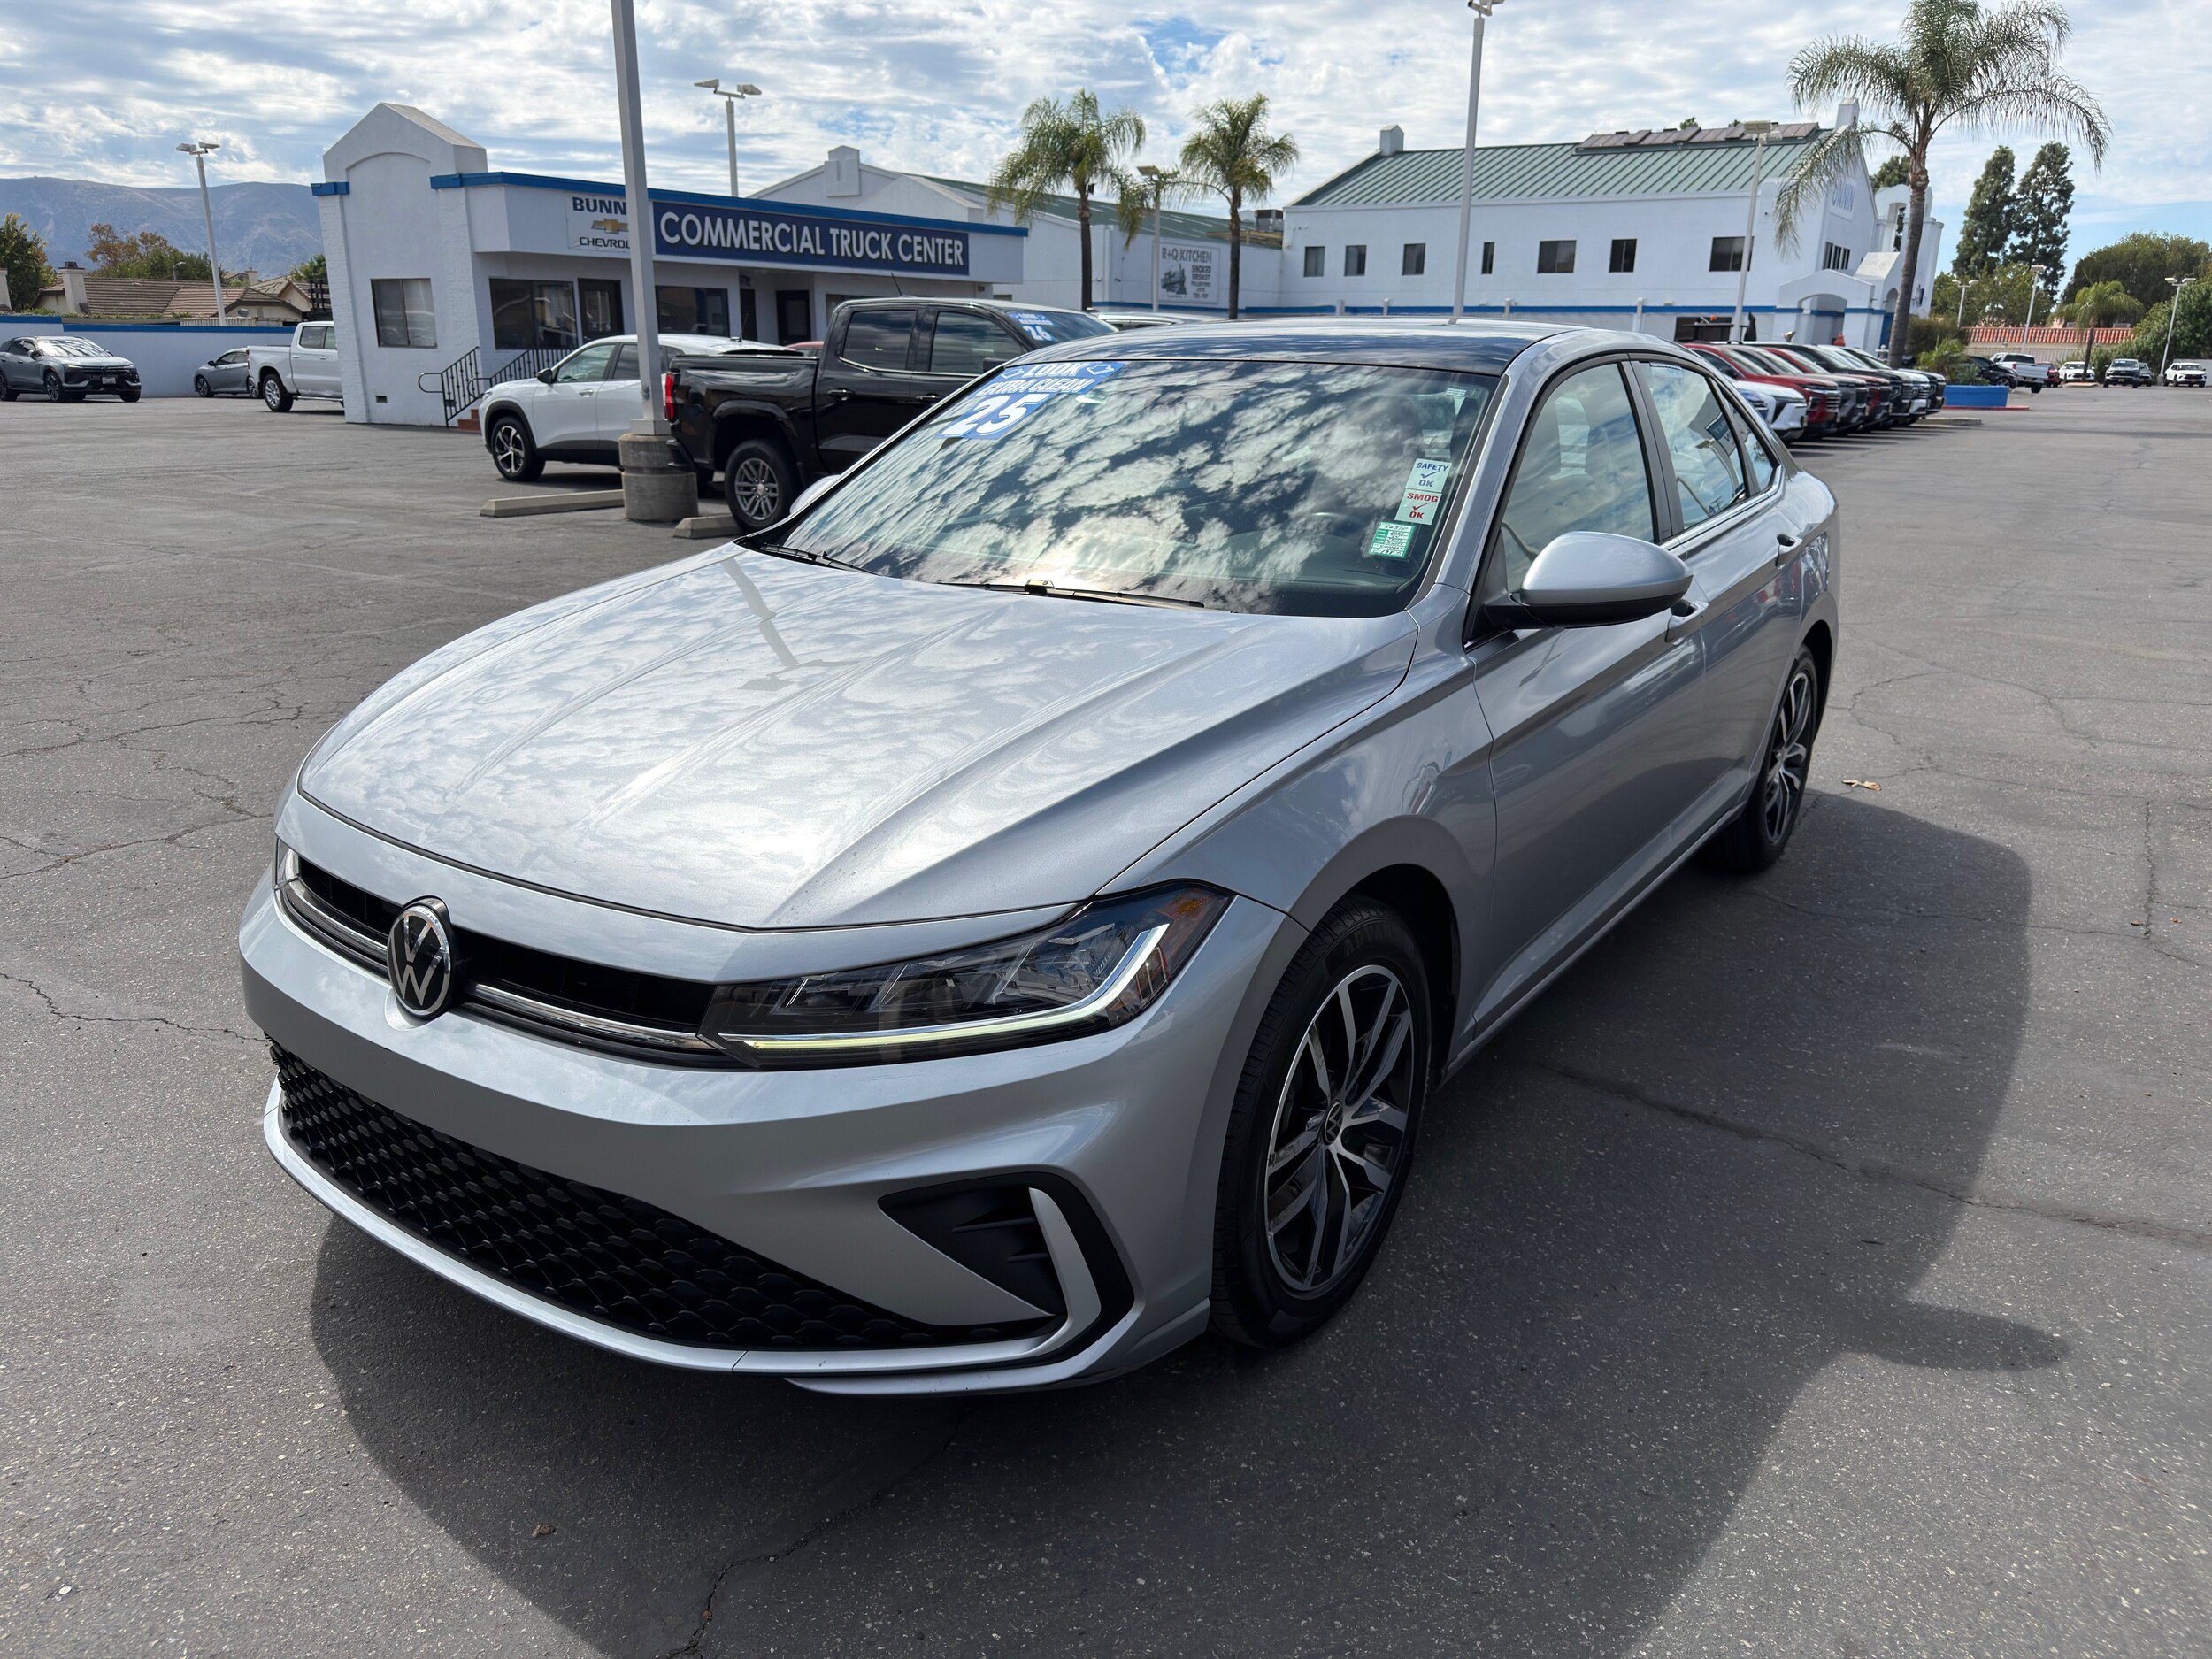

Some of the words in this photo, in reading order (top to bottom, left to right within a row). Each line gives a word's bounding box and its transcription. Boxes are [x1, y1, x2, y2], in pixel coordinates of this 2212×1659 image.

[572, 196, 627, 216] BUNN
[580, 236, 631, 250] CHEVROL
[660, 211, 825, 255] COMMERCIAL
[829, 227, 894, 260] TRUCK
[897, 234, 964, 265] CENTER
[1179, 249, 1213, 264] KITCHEN
[1023, 325, 1054, 342] 26
[1022, 363, 1090, 378] LOOK
[975, 379, 1033, 396] EXTRA
[1028, 378, 1096, 393] CLEAN
[941, 393, 1050, 436] 25
[1416, 462, 1449, 472] SAFETY
[1407, 492, 1439, 503] SMOG
